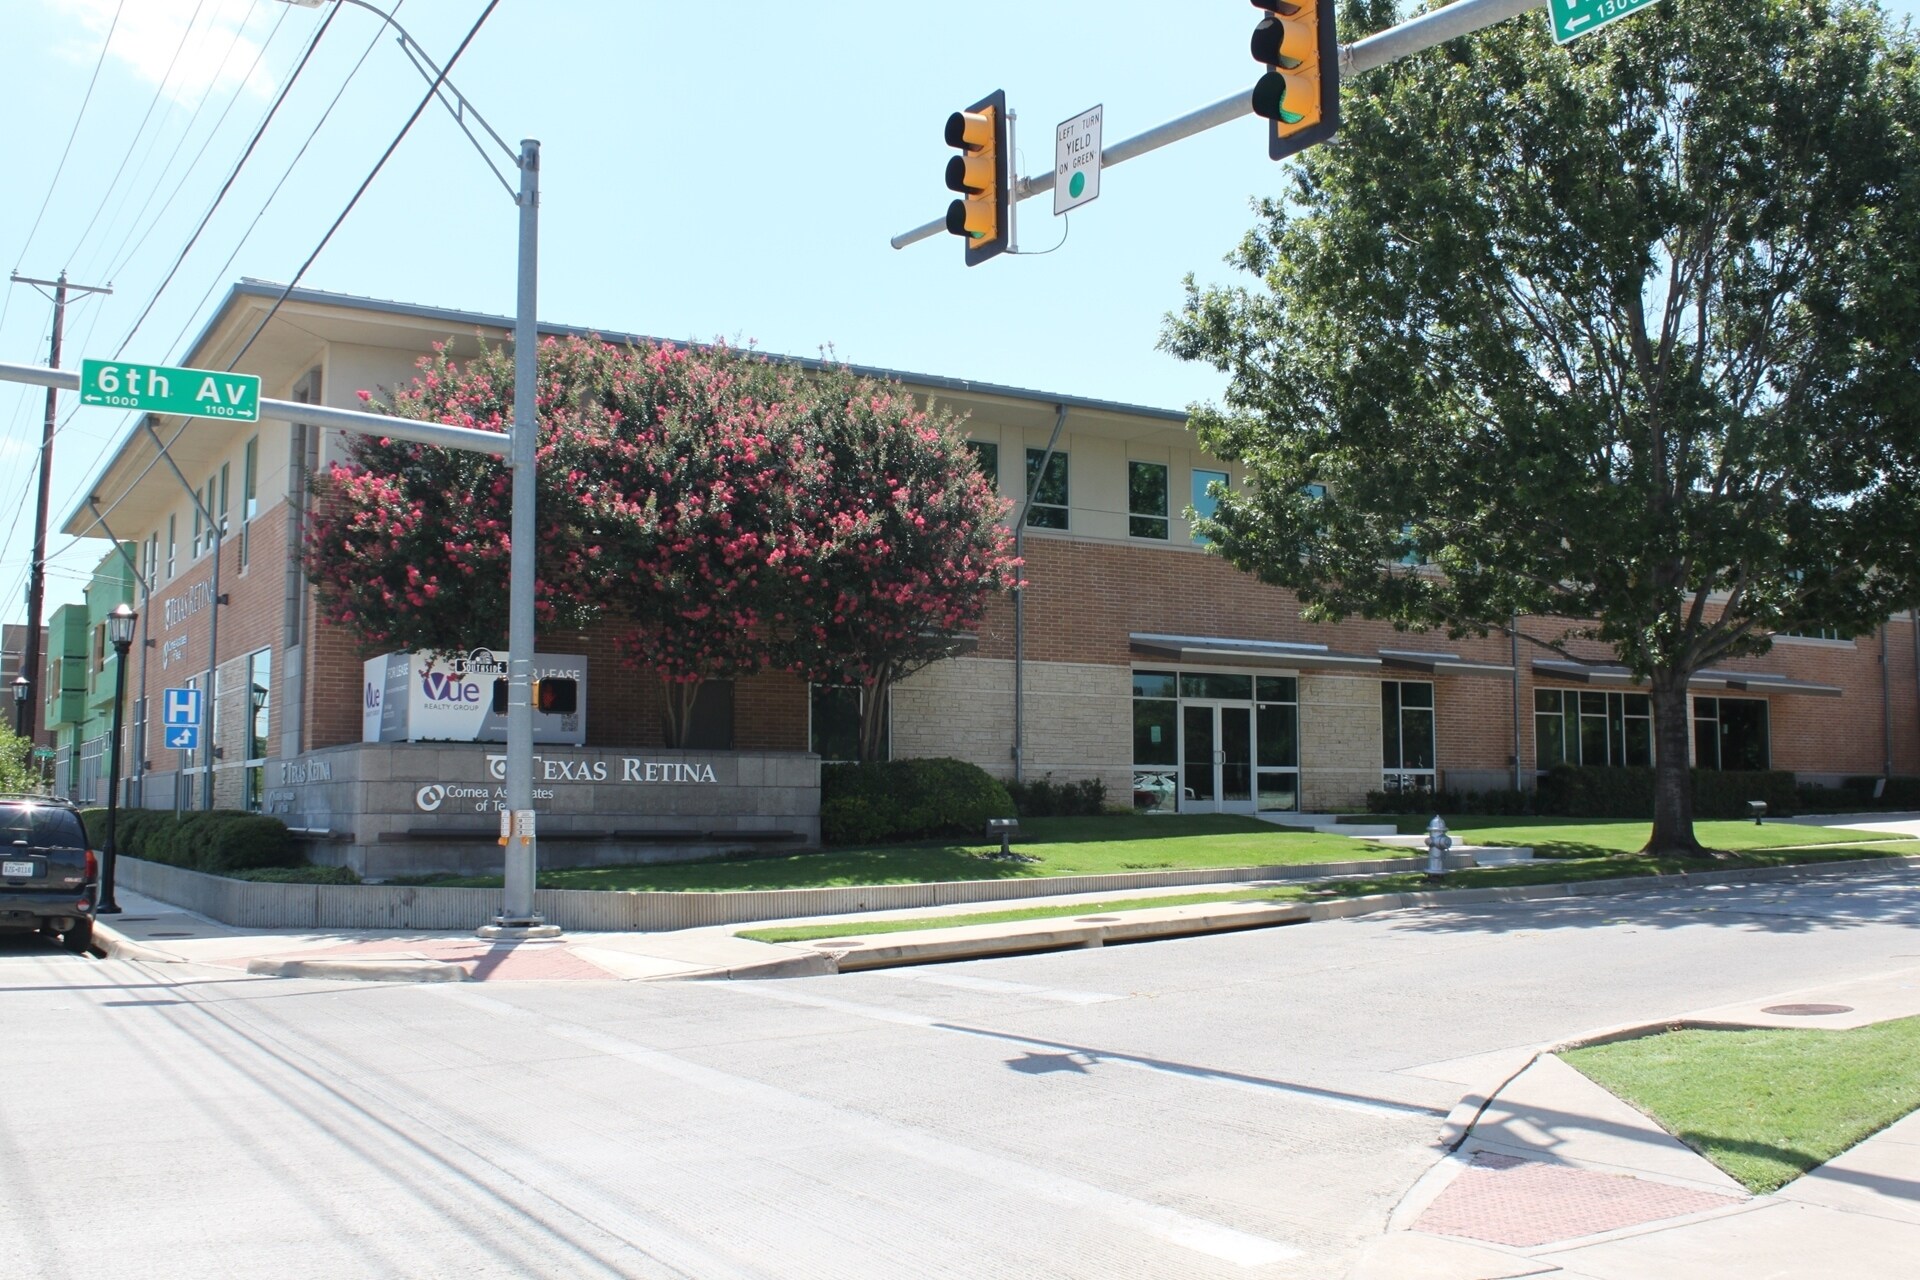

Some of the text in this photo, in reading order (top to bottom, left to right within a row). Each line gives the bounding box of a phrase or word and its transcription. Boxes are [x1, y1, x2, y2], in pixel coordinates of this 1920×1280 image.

[1597, 0, 1639, 18] 130
[1059, 113, 1099, 141] LEFT TURN
[1067, 133, 1091, 156] YIELD
[1059, 151, 1094, 175] ON GREEN
[98, 366, 246, 405] 6th Av
[105, 396, 139, 407] 1000
[205, 405, 234, 416] 1100
[462, 662, 502, 673] SOUTHSIDE
[424, 672, 480, 702] Vue
[169, 690, 196, 723] H
[424, 703, 451, 711] REALTY
[622, 757, 717, 783] RETINA
[446, 785, 554, 799] Cornea Asates
[475, 800, 487, 812] of
